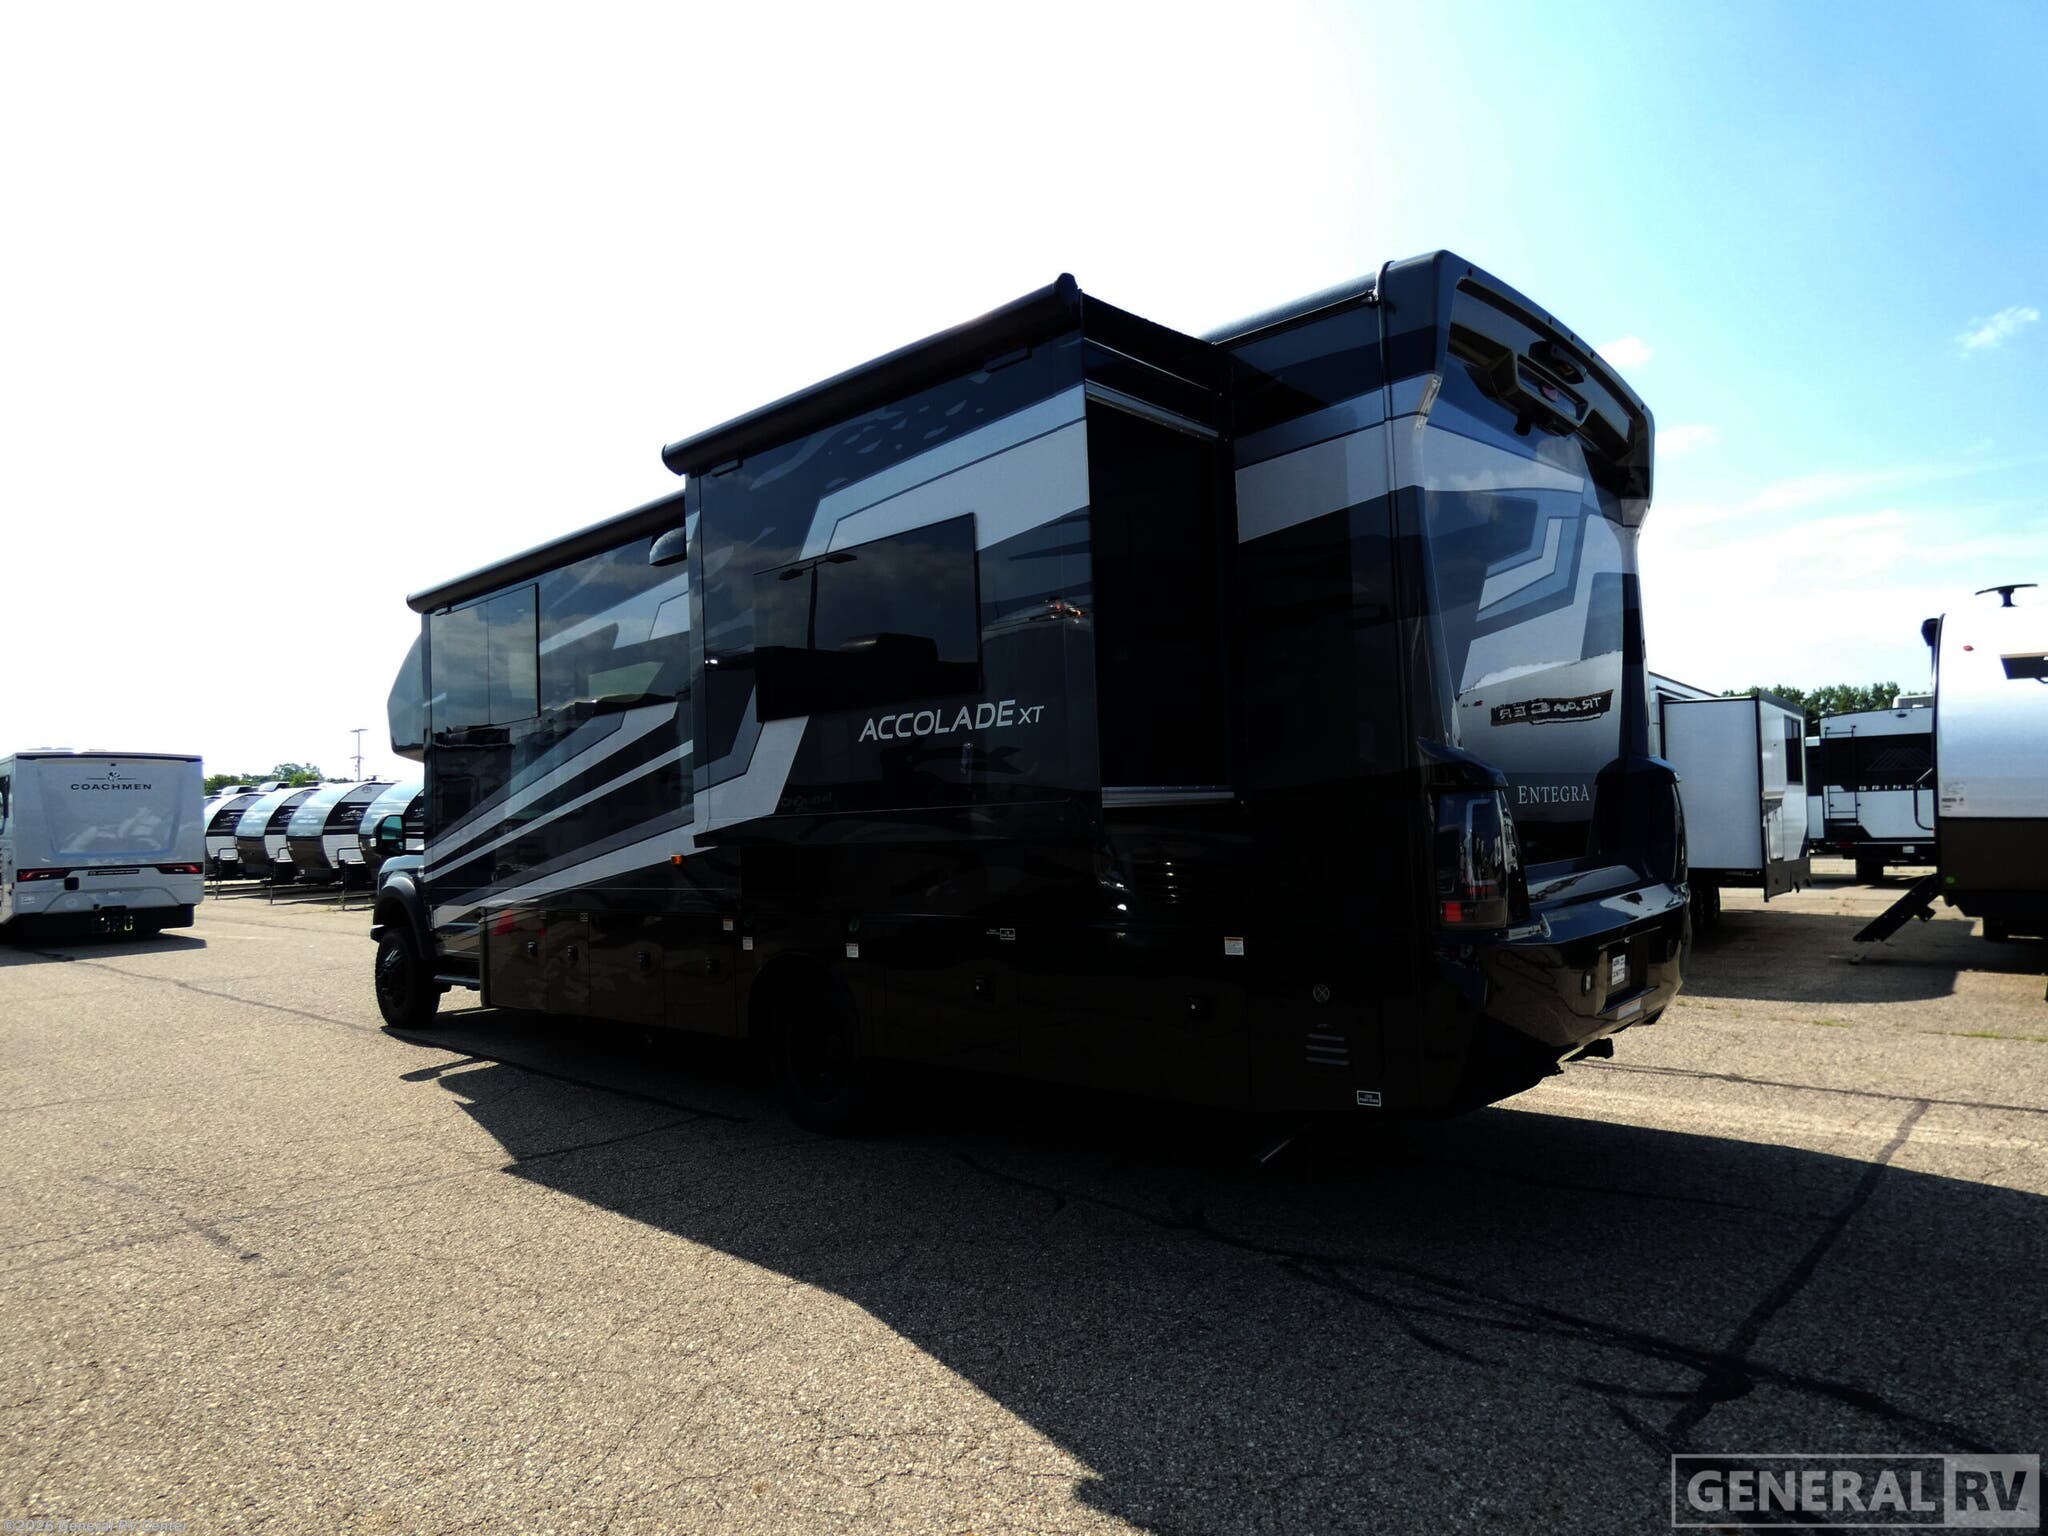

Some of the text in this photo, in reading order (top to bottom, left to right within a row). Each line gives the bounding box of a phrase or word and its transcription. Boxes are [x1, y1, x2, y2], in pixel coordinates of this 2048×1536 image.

[858, 699, 1045, 743] ACCOLADE XT
[70, 783, 152, 791] COACHMEN
[1517, 783, 1590, 804] ENTEGRA
